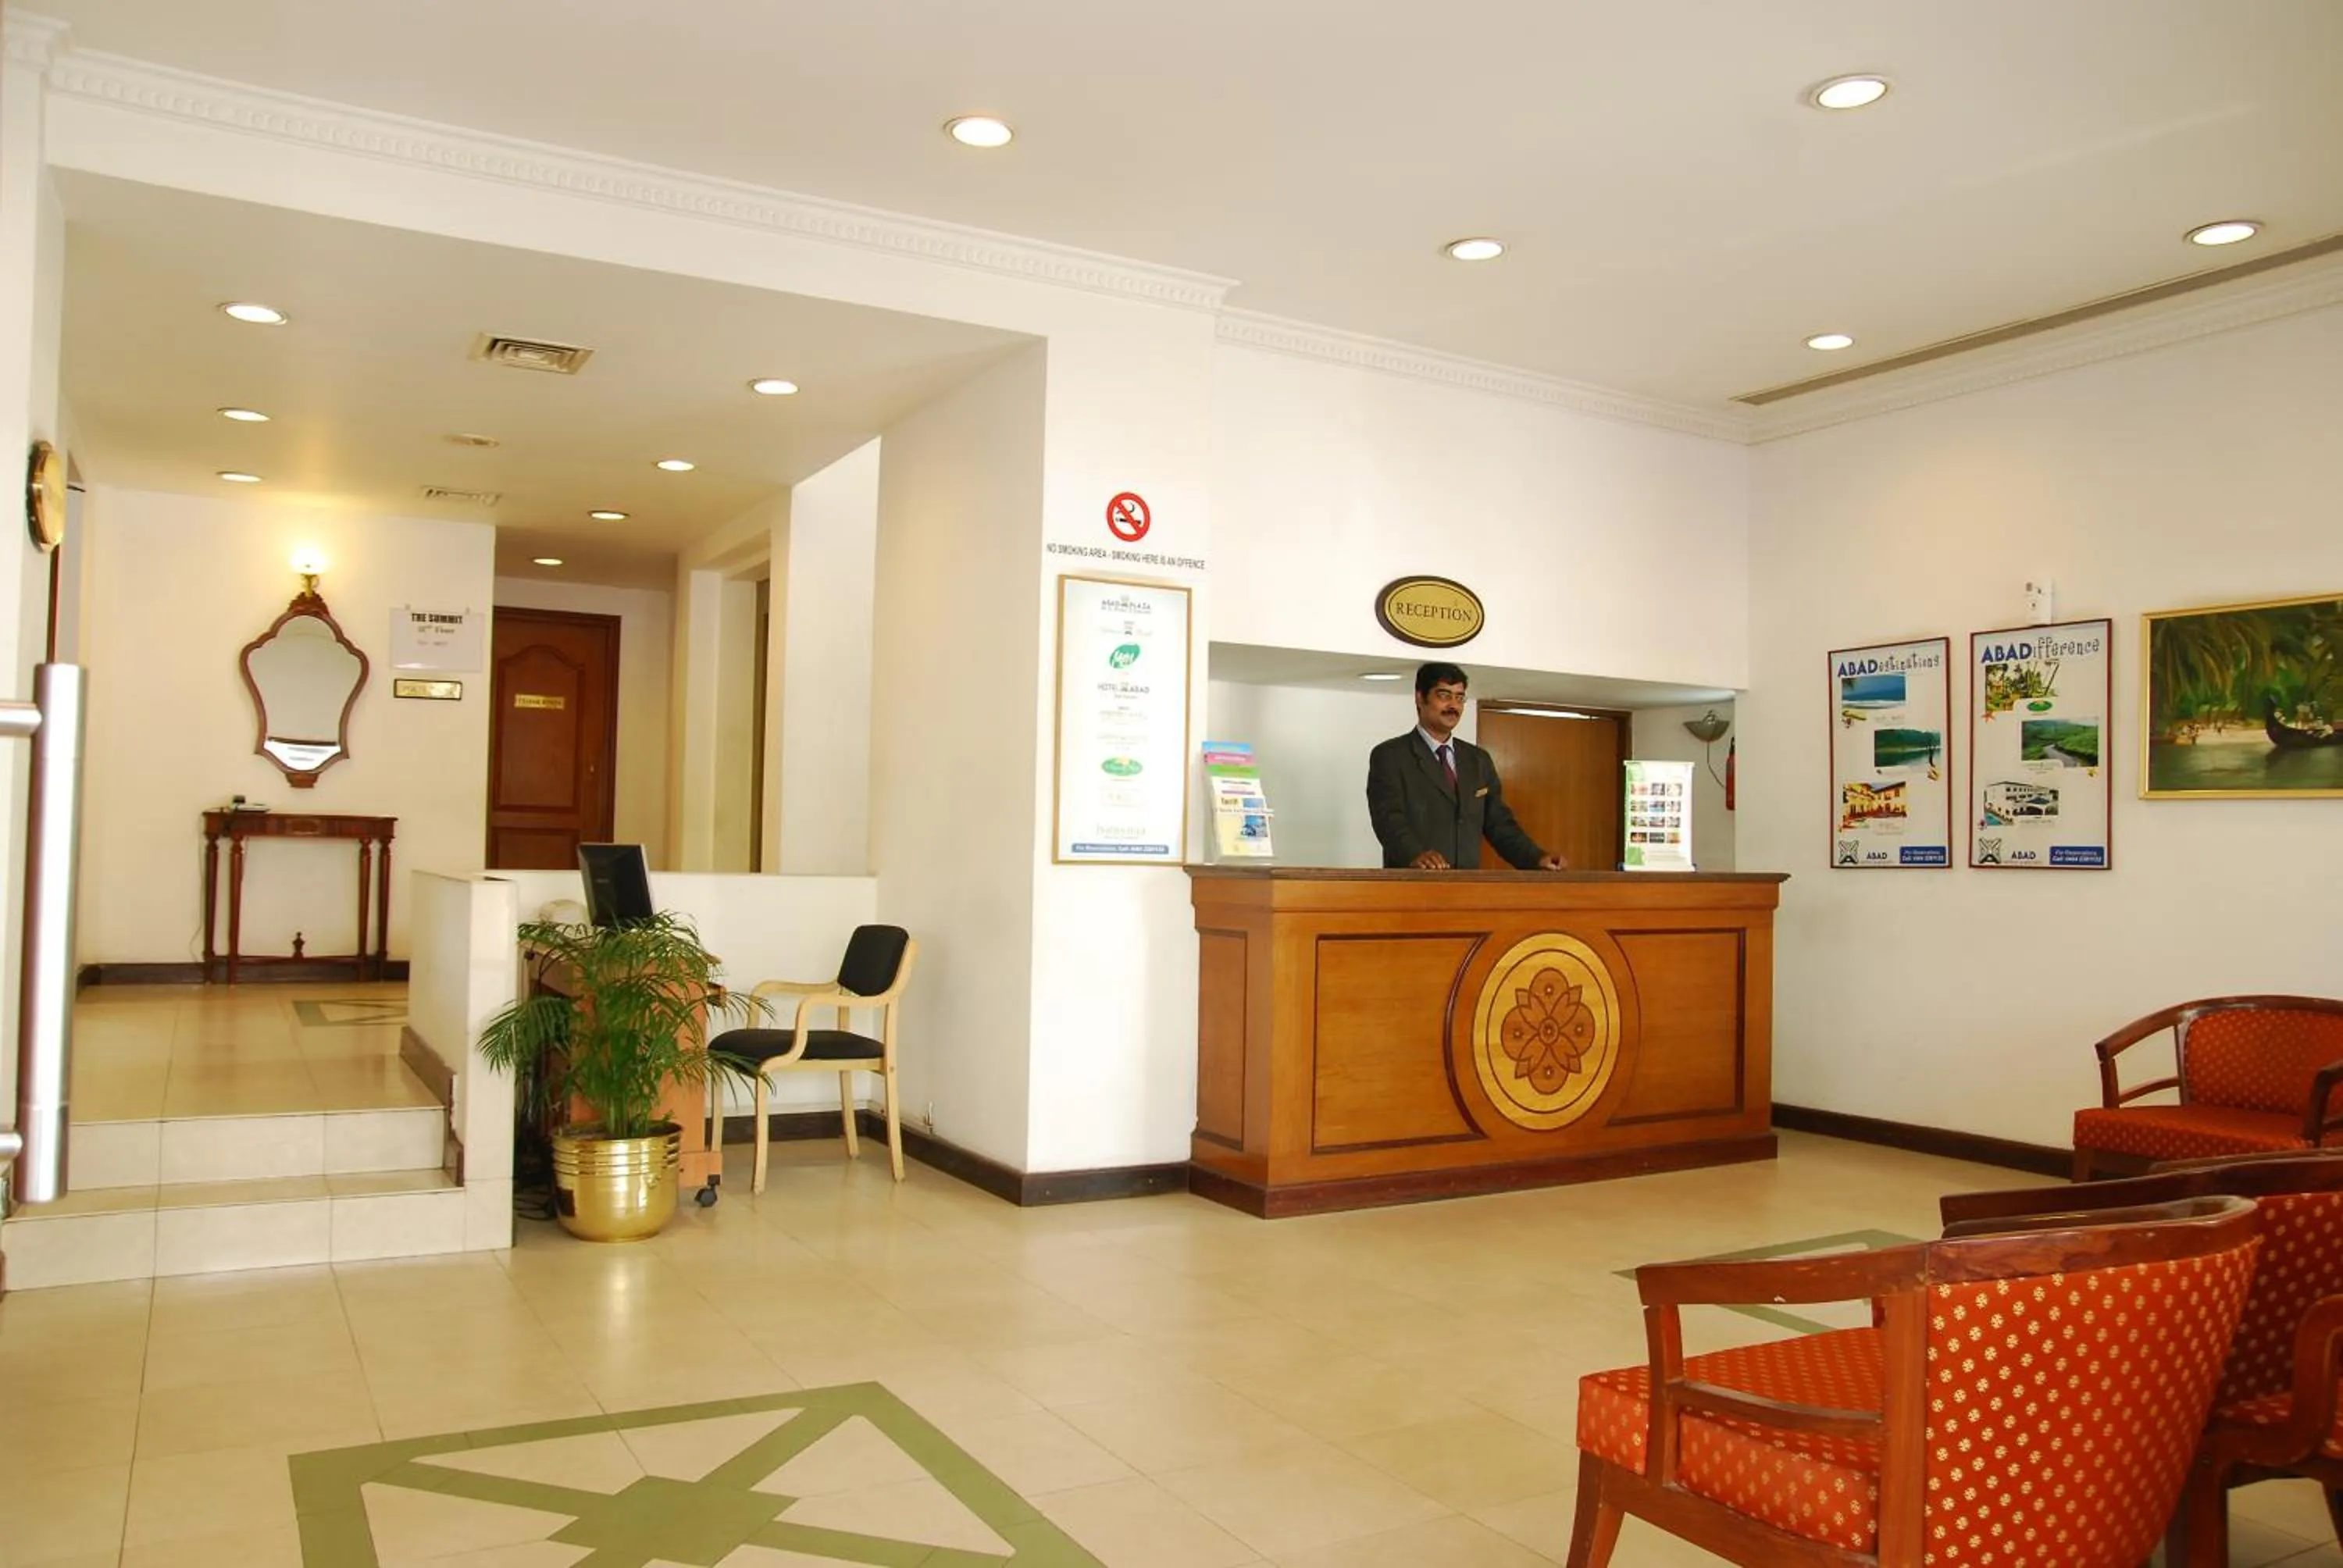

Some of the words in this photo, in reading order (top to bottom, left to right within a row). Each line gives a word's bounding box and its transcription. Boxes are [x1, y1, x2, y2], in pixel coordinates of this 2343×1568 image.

[1047, 543, 1057, 554] NO
[1058, 544, 1088, 558] SMOKING
[1089, 547, 1107, 558] AREA
[1111, 550, 1141, 563] SMOKING
[1142, 554, 1159, 565] HERE
[1160, 554, 1167, 566] IS
[1167, 556, 1176, 566] AN
[1177, 557, 1206, 570] OFFENCE
[1395, 601, 1472, 622] RECEPTION
[412, 613, 427, 622] THE
[429, 614, 463, 625] SUMMIT
[1866, 851, 1888, 861] ABAD
[2011, 850, 2036, 861] ABAD
